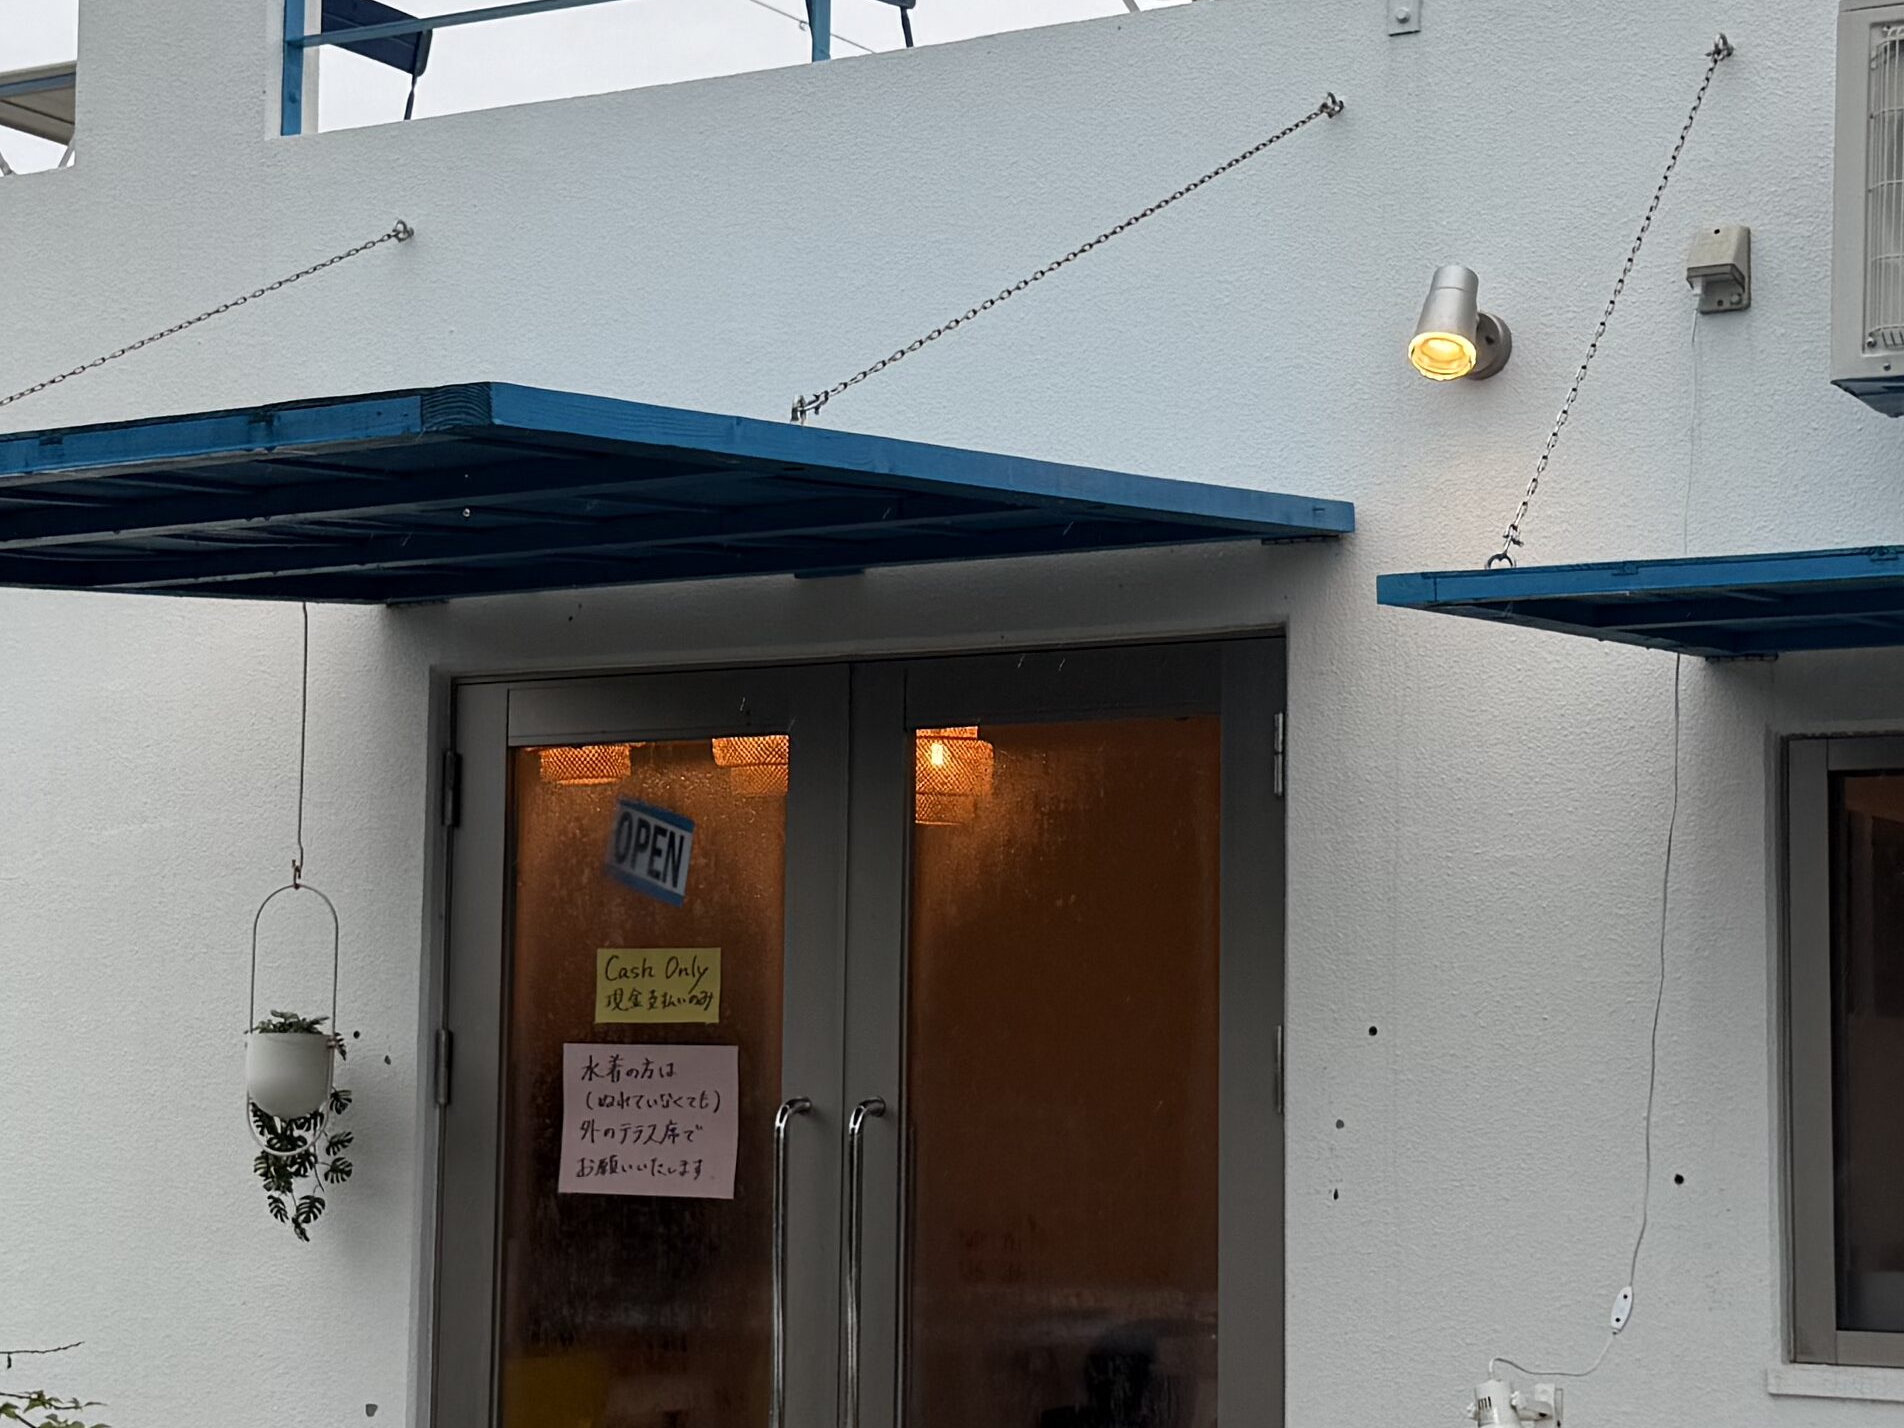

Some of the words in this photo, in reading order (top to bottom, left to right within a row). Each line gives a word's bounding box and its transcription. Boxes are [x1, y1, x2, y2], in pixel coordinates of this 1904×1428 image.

[614, 811, 685, 889] OPEN
[605, 955, 655, 982] Cash
[665, 956, 709, 995] Only
[605, 988, 714, 1012] 現金支払いのみ
[581, 1053, 676, 1083] 水着の方は
[580, 1119, 704, 1145] 外のテラス席で
[576, 1154, 703, 1181] お願いいたします
